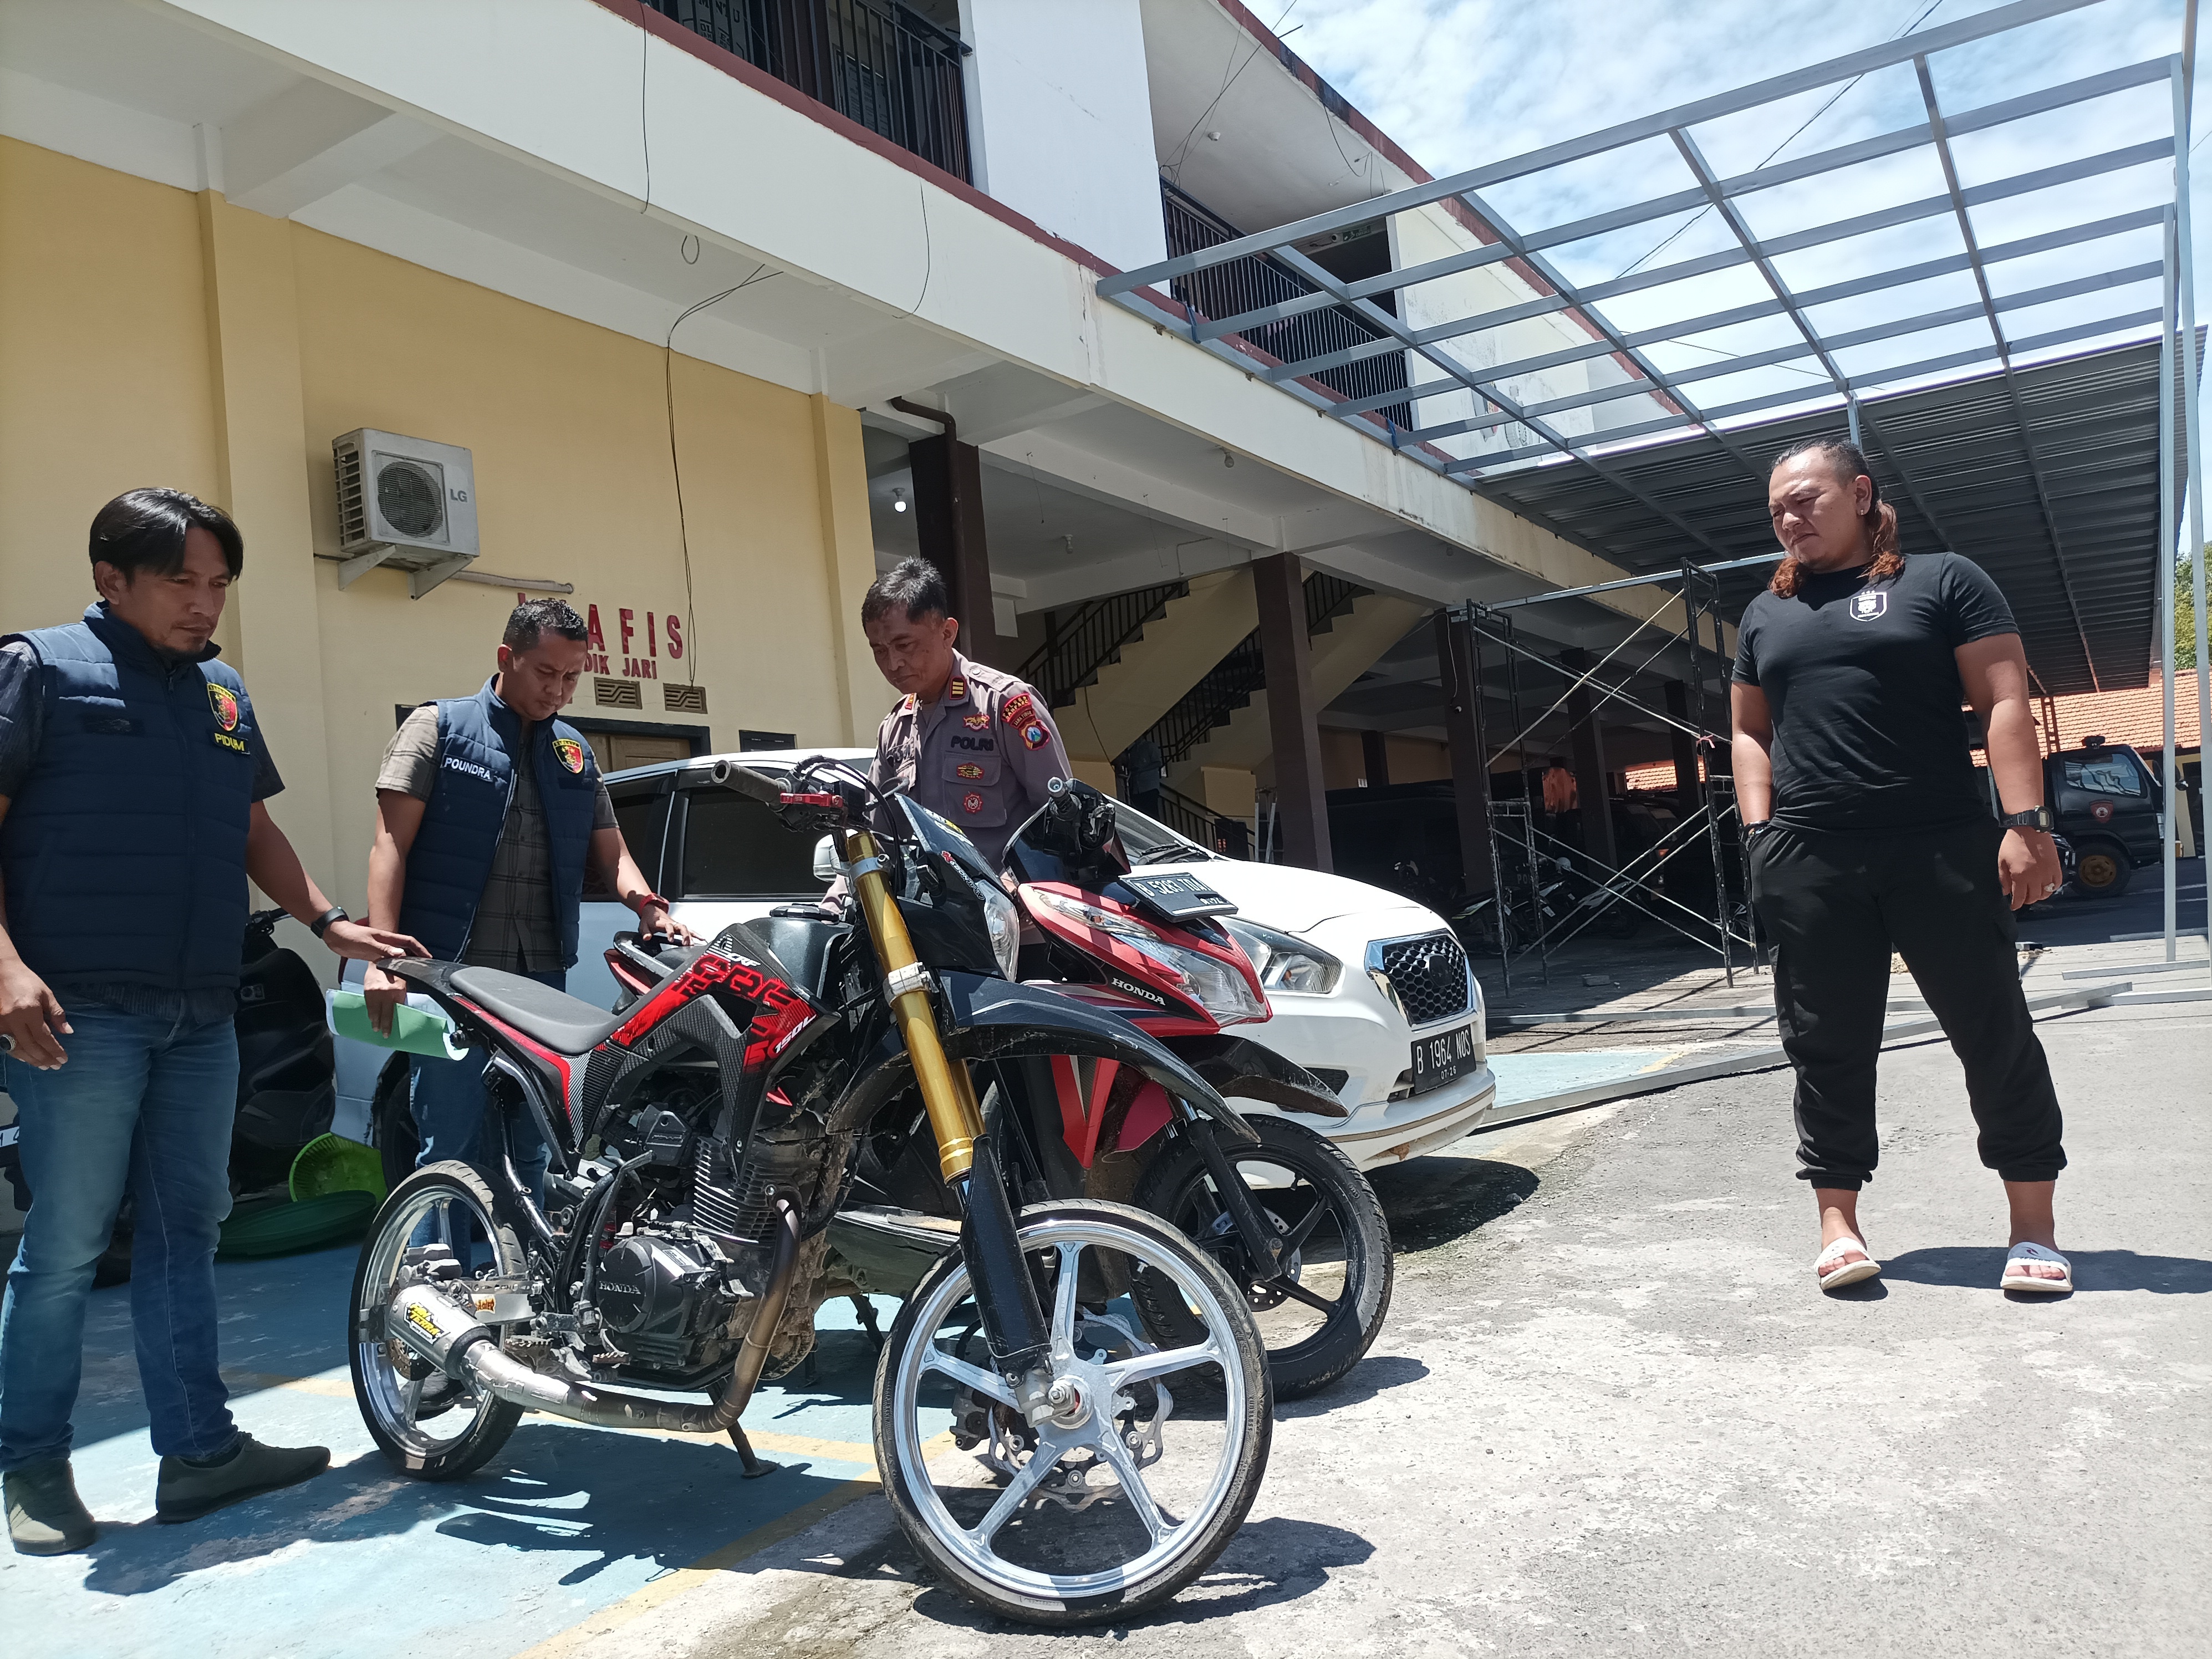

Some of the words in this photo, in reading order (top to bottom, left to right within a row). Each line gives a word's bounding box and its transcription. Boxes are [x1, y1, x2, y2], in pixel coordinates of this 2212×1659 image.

[450, 488, 468, 503] LG
[622, 658, 658, 679] JARI
[214, 732, 245, 751] PIDUM
[950, 735, 994, 751] POLRI
[444, 757, 491, 780] POUNDRA
[1134, 882, 1155, 897] B
[1147, 879, 1184, 895] 5283
[1111, 977, 1166, 1006] HONDA
[774, 1014, 817, 1054] 150L
[1416, 1045, 1424, 1074] B
[1429, 1036, 1452, 1069] 1964
[599, 1280, 641, 1295] HONDA
[409, 1310, 441, 1336] TERRA
